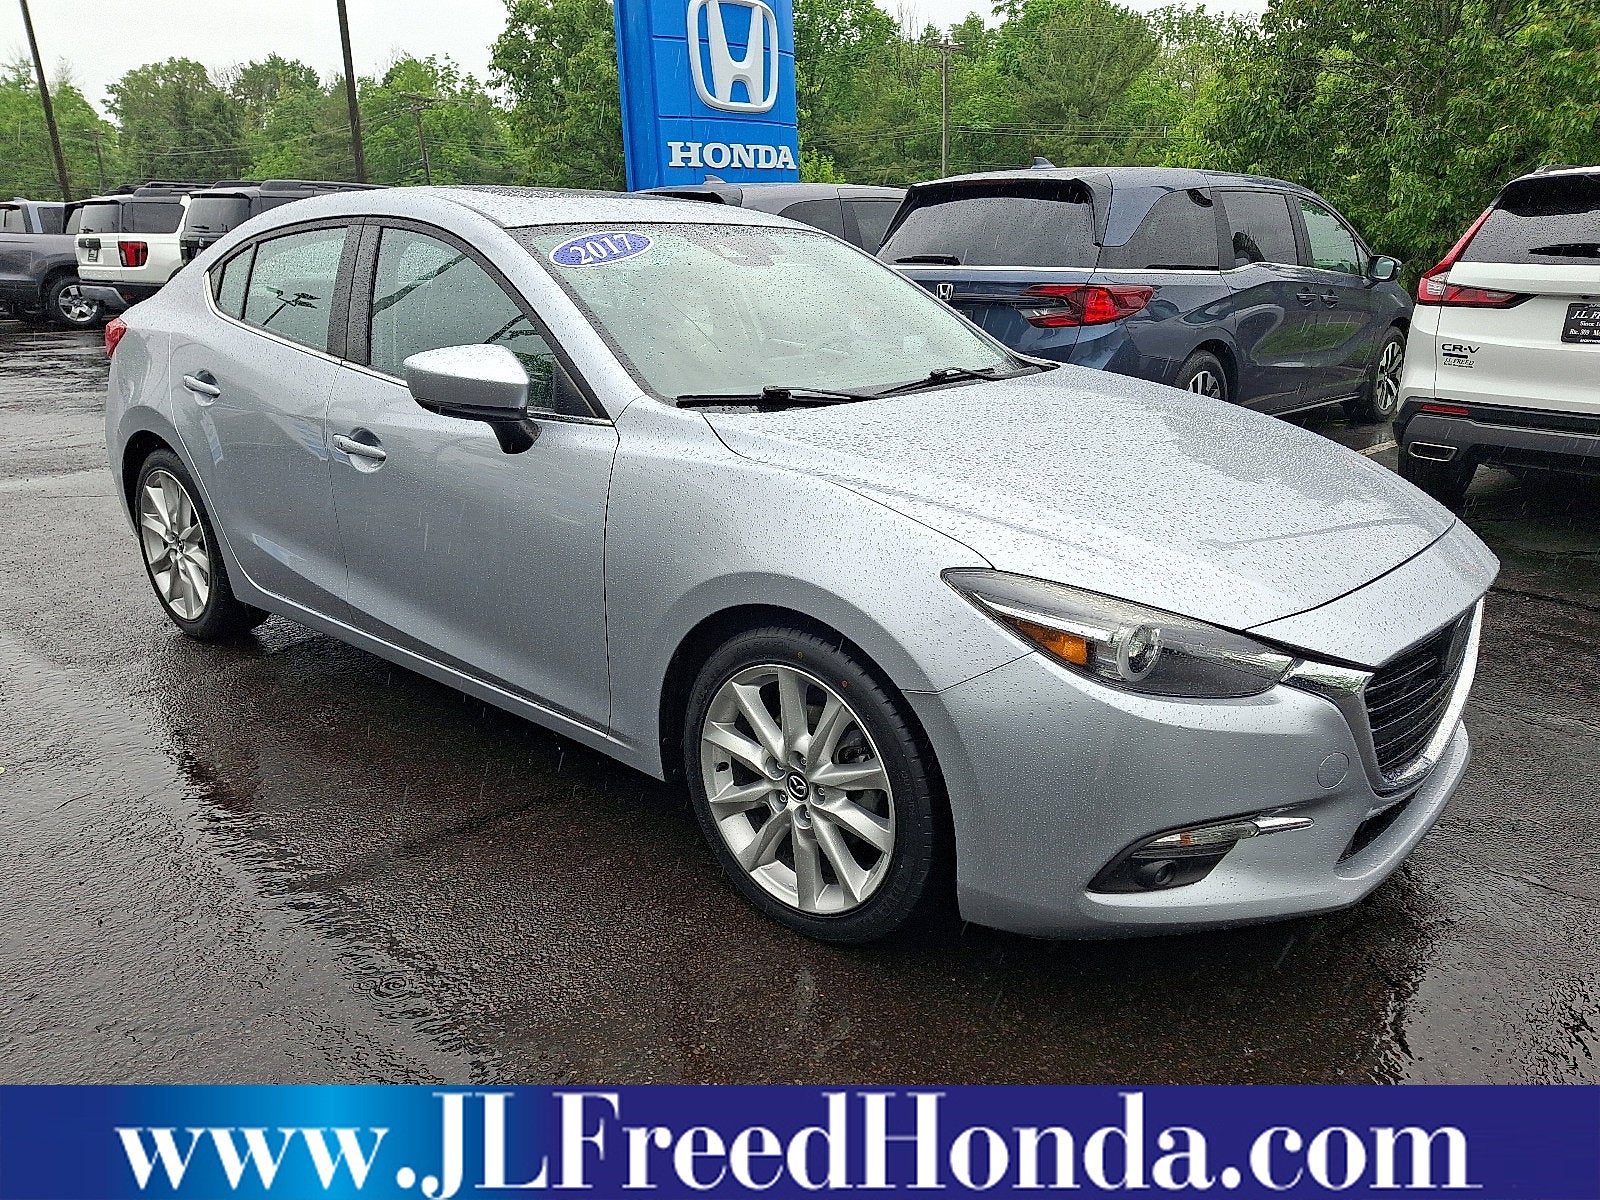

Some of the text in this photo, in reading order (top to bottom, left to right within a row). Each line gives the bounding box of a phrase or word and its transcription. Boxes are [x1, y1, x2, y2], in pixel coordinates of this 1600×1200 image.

[667, 141, 798, 170] HONDA
[569, 234, 632, 264] 2017
[1441, 343, 1480, 353] CR-V
